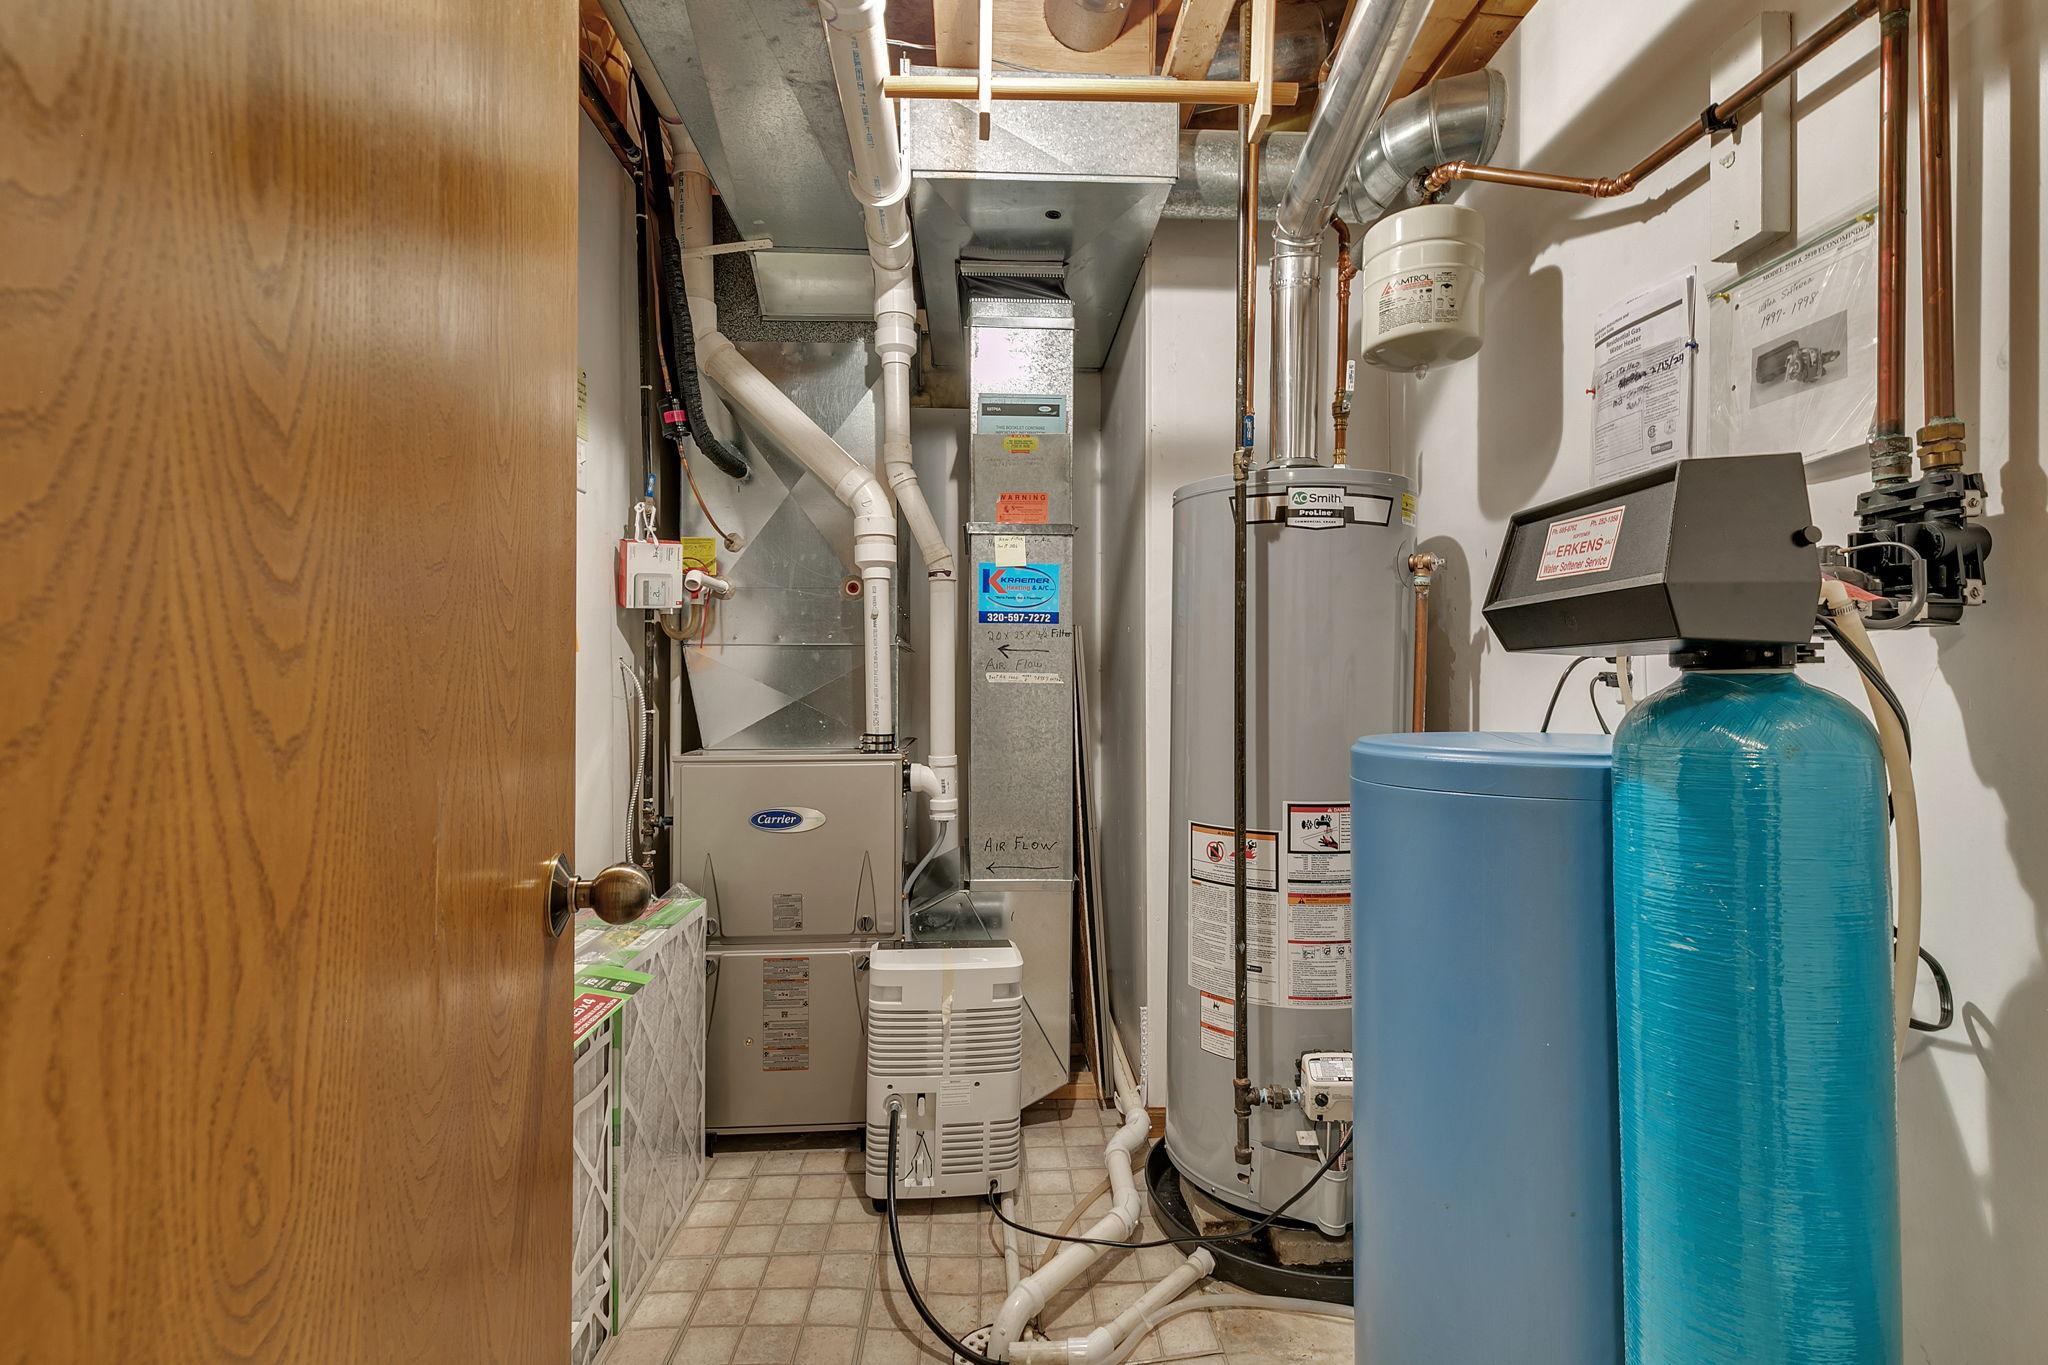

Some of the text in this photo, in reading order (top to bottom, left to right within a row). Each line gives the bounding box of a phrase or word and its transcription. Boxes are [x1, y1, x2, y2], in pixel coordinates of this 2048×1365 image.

[1393, 274, 1432, 287] AMTROL
[1631, 327, 1641, 335] Gas
[1624, 335, 1641, 347] Heater
[1309, 493, 1341, 503] Smith
[1555, 537, 1604, 558] ERKENS
[1543, 555, 1608, 574] Water Softener Service
[987, 613, 1051, 622] 320-597-7272
[1051, 628, 1073, 638] Filter
[757, 814, 797, 824] Carrier
[984, 835, 1058, 852] AIR FLOW
